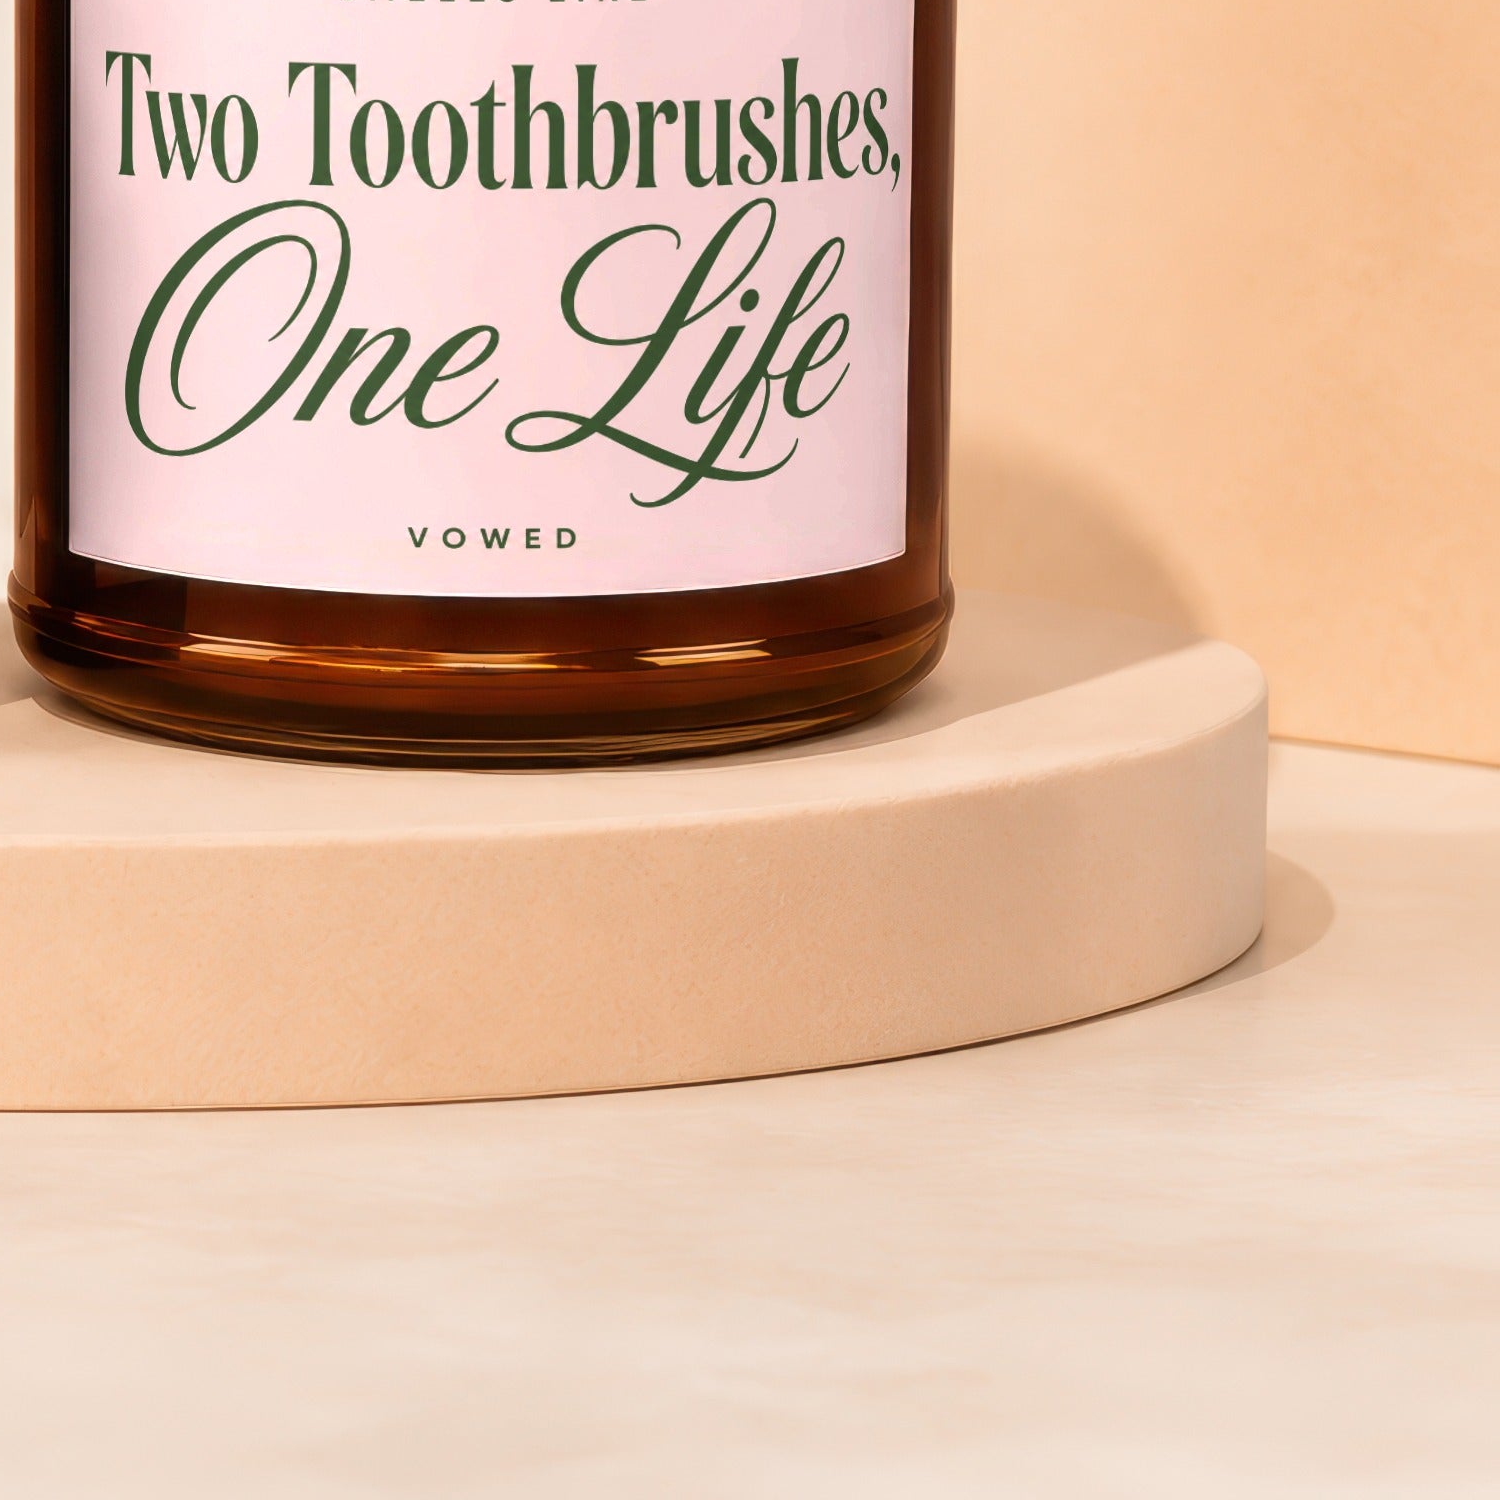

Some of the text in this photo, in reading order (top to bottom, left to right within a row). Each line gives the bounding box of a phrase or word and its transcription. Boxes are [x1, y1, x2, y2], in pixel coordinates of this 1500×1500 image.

[105, 50, 902, 193] Two Toothbrushes,
[124, 197, 851, 509] One Life
[407, 525, 579, 551] VOWED
